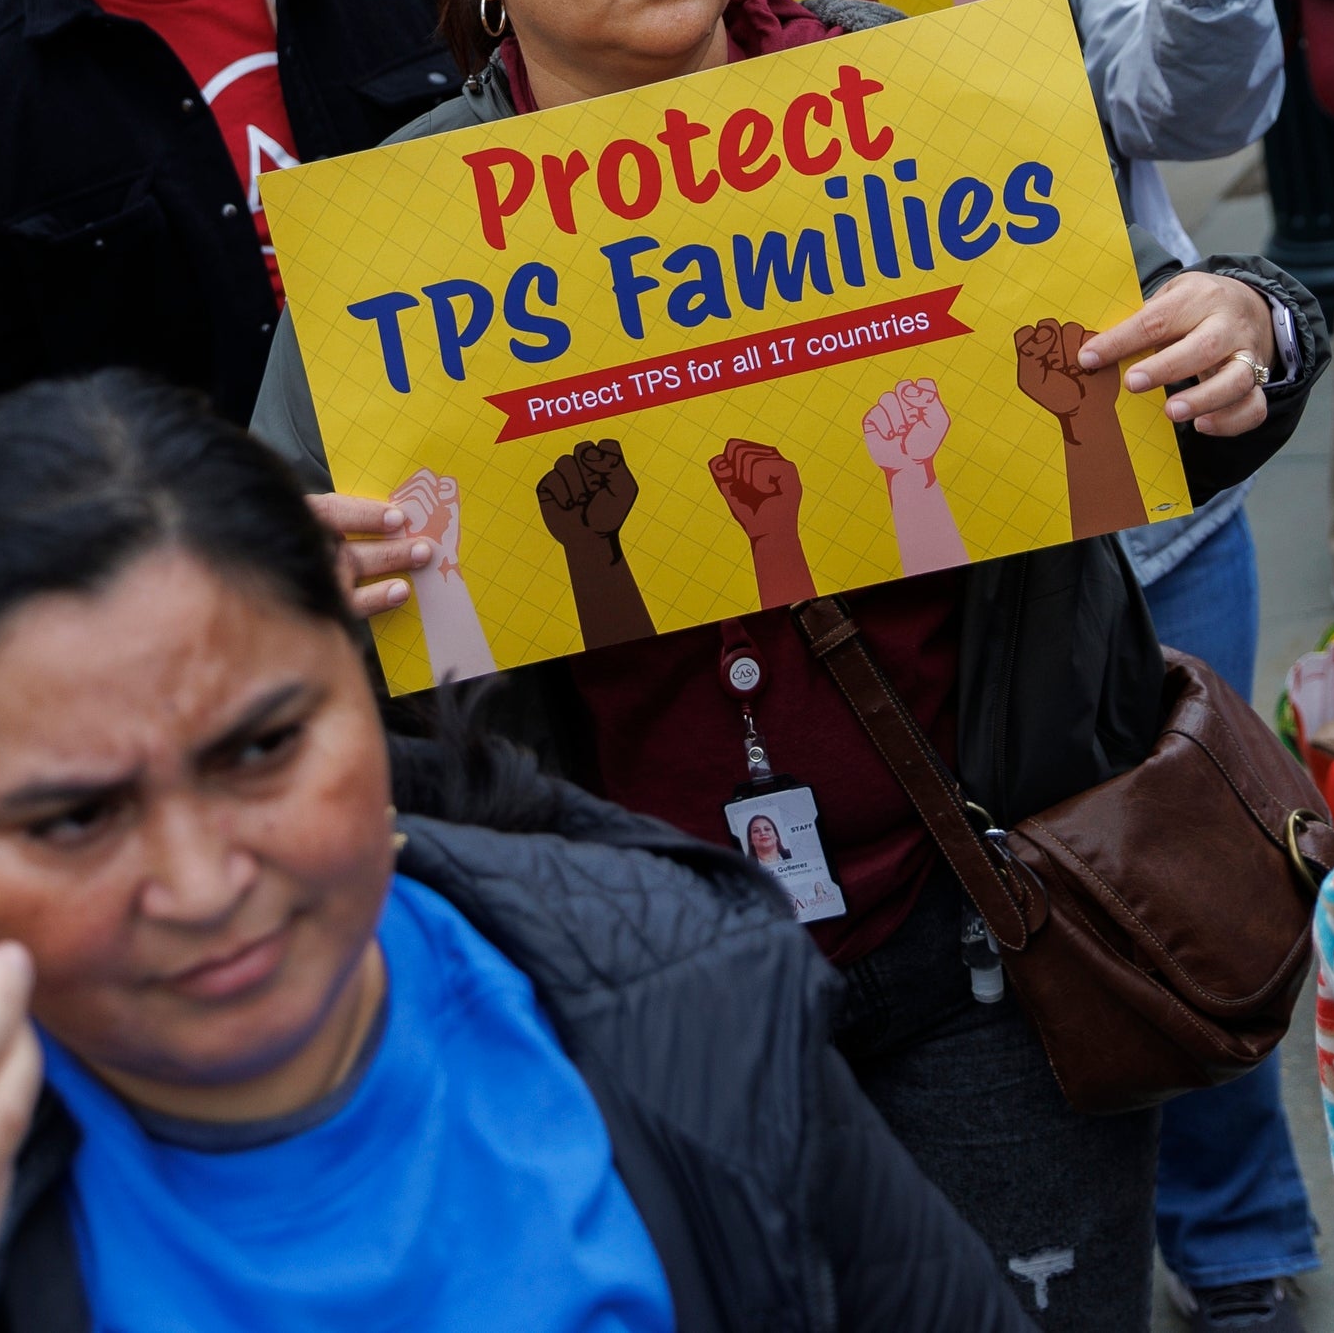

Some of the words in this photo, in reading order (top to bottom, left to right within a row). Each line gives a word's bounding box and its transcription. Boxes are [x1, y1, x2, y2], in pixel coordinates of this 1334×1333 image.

[464, 65, 894, 250] Protect
[347, 262, 571, 394] TPS
[600, 158, 1061, 340] Families
[526, 380, 624, 422] Protect
[628, 365, 681, 397] TPS
[686, 356, 723, 384] for
[732, 345, 762, 374] all
[767, 337, 797, 365] 17
[806, 311, 930, 356] countries
[732, 667, 758, 680] CASA
[790, 823, 813, 833] STAFF
